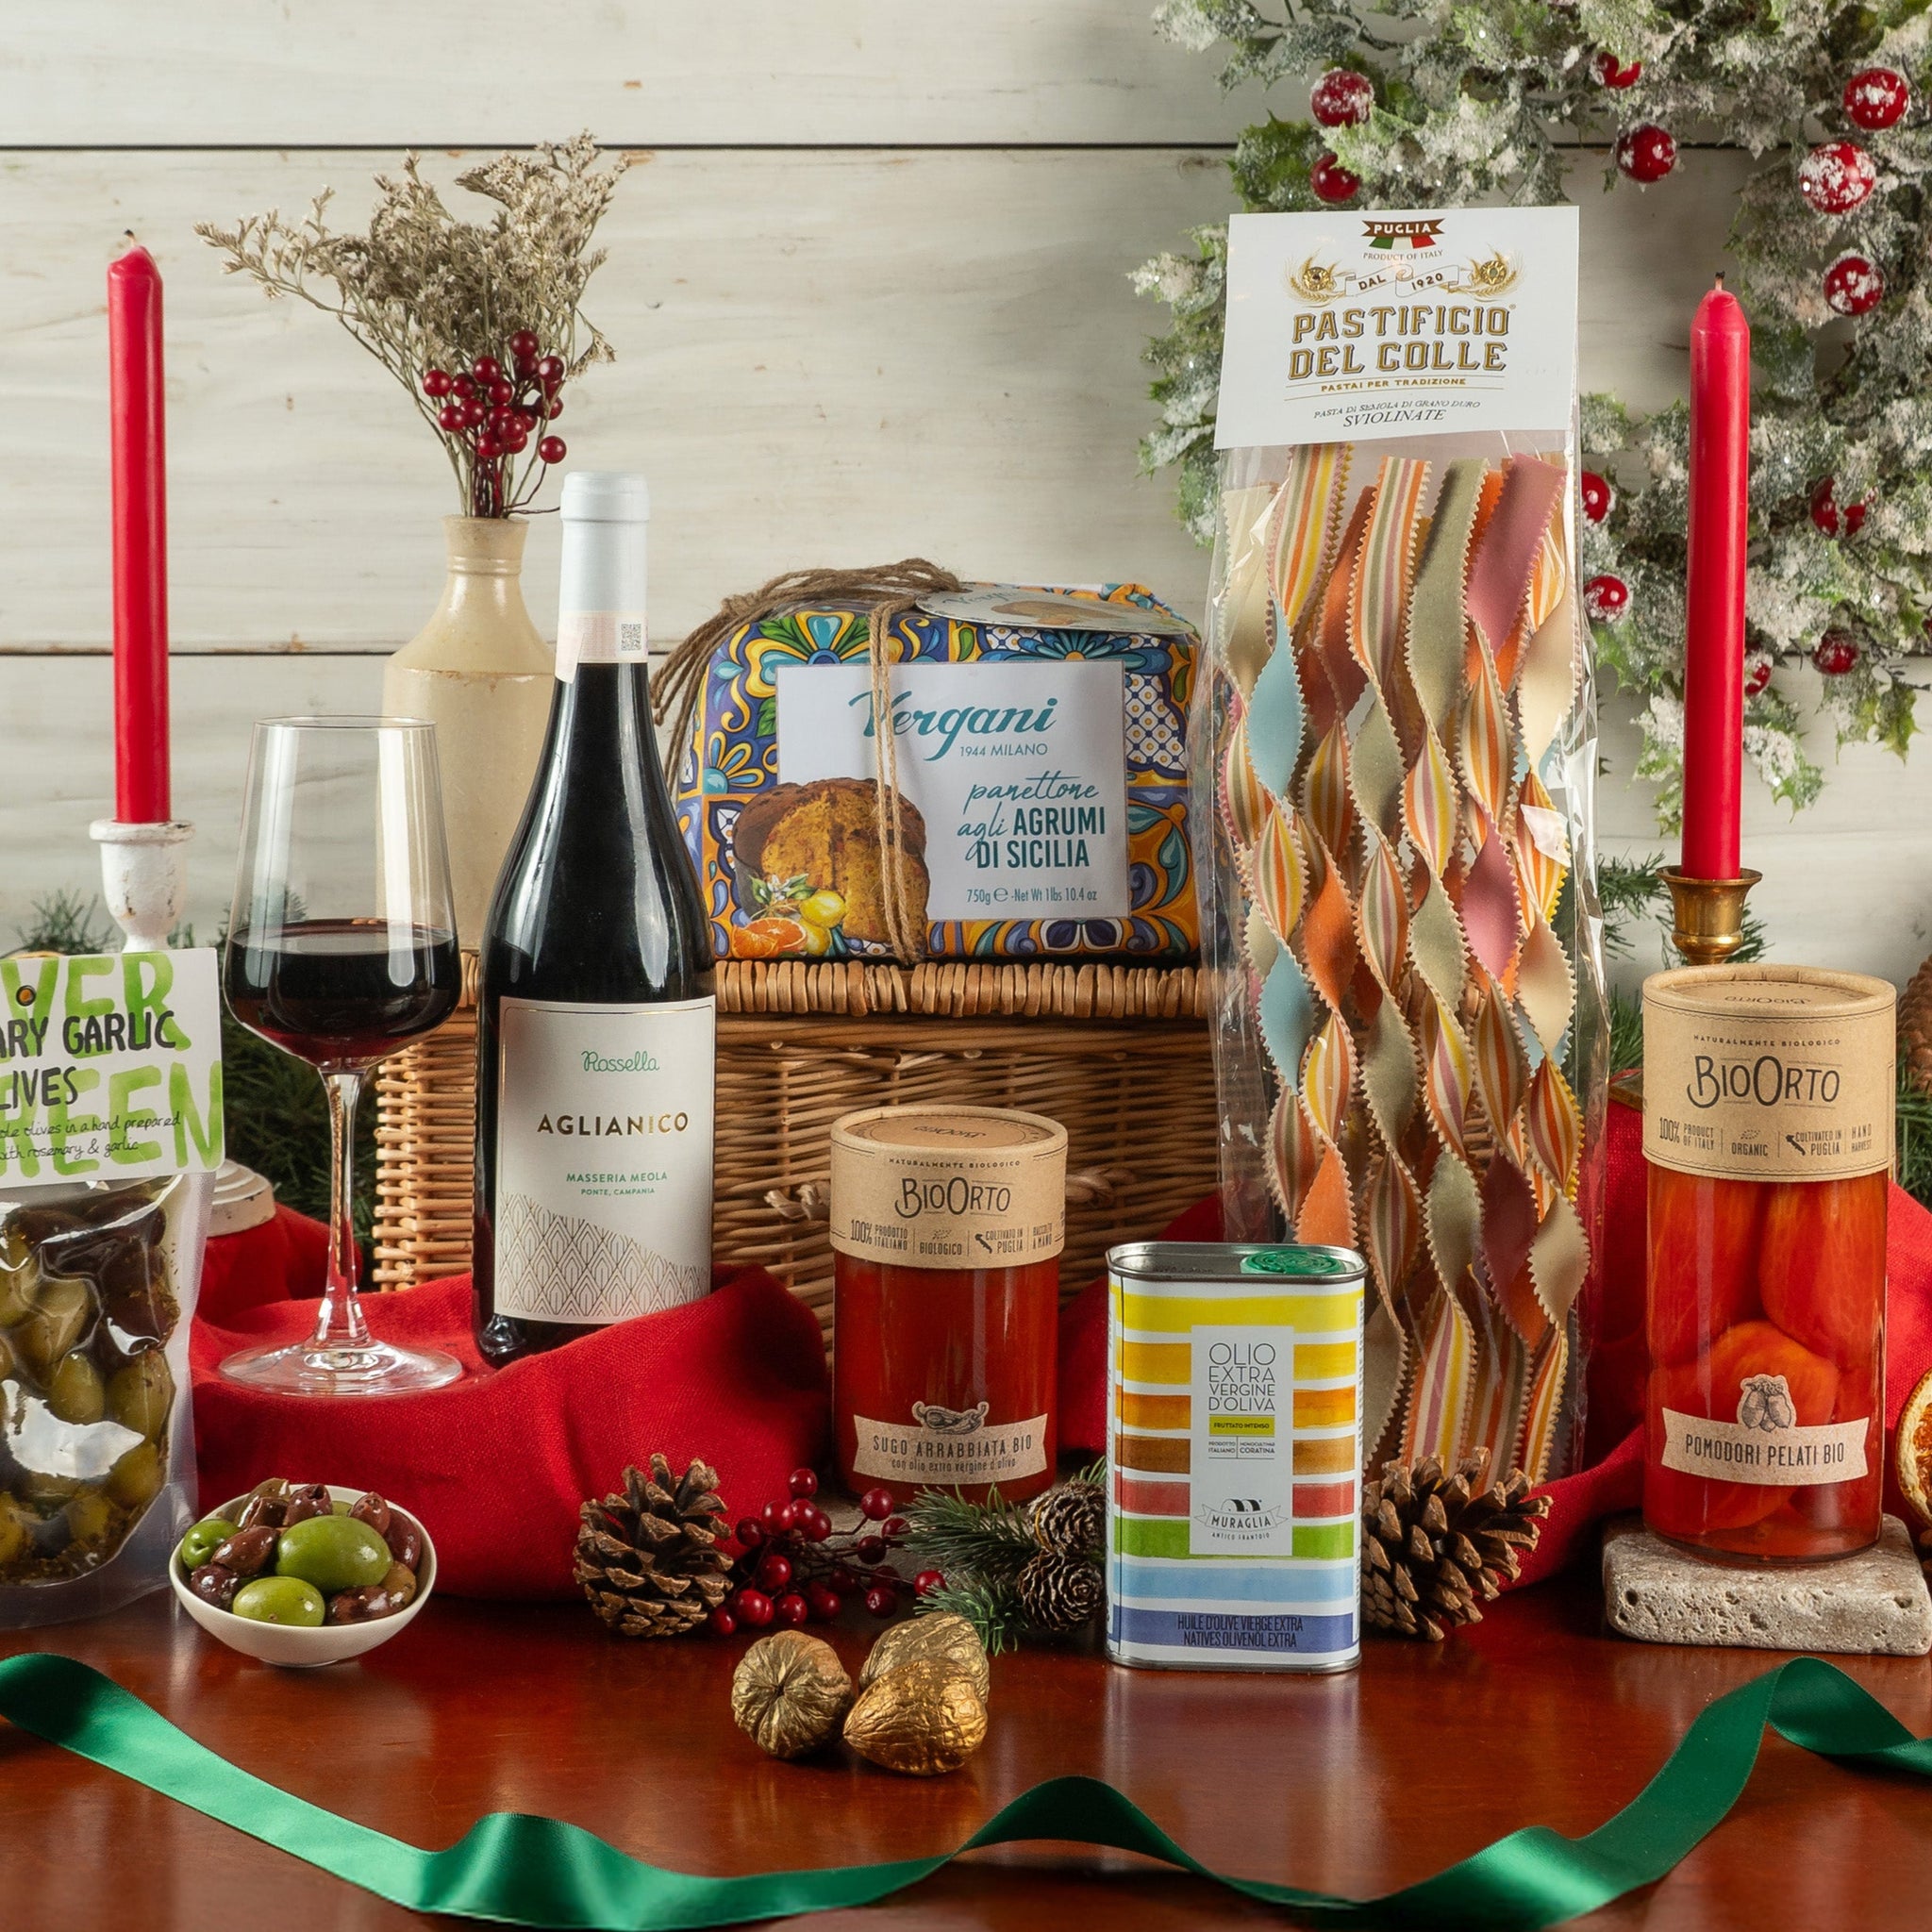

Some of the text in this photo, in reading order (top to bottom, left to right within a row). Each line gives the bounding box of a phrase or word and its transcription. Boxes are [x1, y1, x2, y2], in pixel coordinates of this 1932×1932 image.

[1373, 223, 1431, 234] PUGLIA
[1363, 252, 1404, 260] PRODUCT
[1420, 249, 1443, 258] ITALY
[1358, 273, 1443, 291] DAL 1920
[1291, 305, 1510, 343] PASTIFICIO
[1288, 341, 1508, 380] DEL COLLE
[1321, 383, 1363, 392] PASTAI
[1395, 378, 1466, 387] TRADIZIONE
[1314, 408, 1343, 419] PASTA
[1359, 402, 1399, 411] SEMOLA
[1401, 400, 1413, 408] DI
[1451, 400, 1481, 408] DURO
[1342, 408, 1447, 427] SVIOLINATE
[848, 690, 1058, 762] Vergani
[960, 742, 1048, 758] 1944 MILANO
[962, 770, 1100, 815] panettone
[957, 802, 1106, 861] agli AGRUMI
[976, 839, 1091, 870] DI SICILIA
[967, 889, 991, 906] 750g
[1031, 888, 1042, 902] Wt
[1065, 887, 1085, 901] 10.4
[1087, 890, 1098, 901] oz
[0, 953, 192, 1059] VER
[62, 1010, 176, 1055] GARLIC
[1693, 1035, 1840, 1047] NATURALMENTE BIOLOGICO
[581, 1051, 660, 1073] Rossella
[25, 1120, 60, 1137] olives
[66, 1122, 77, 1133] in
[81, 1124, 91, 1132] a
[92, 1115, 120, 1132] hand
[124, 1111, 181, 1133] prepared
[537, 1111, 689, 1137] AGLIANICO
[1659, 1117, 1714, 1143] 100% PRODUCT
[1851, 1124, 1872, 1139] HAND
[1683, 1136, 1714, 1150] OF ITALY
[1795, 1130, 1841, 1142] CULTIVATED IN
[27, 1143, 83, 1159] rosemary
[88, 1138, 99, 1155] &
[104, 1137, 140, 1158] garlic
[1732, 1142, 1769, 1157] ORGANIC
[1810, 1142, 1840, 1157] PUGLIA
[889, 1158, 963, 1168] NATURALMENTE
[566, 1172, 668, 1184] MASSERIA MEOLA
[581, 1188, 656, 1197] PONTE, CAMPANIA
[851, 1219, 908, 1245] 100% PRODOTTO
[986, 1228, 1015, 1241] COLTIVATO
[874, 1236, 908, 1251] ITALIANO
[919, 1241, 962, 1256] BIOLOGICO
[997, 1240, 1024, 1254] PUGLIA
[1208, 1342, 1276, 1366] OLIO
[1208, 1366, 1275, 1383] EXTRA
[1208, 1383, 1275, 1397] VERGINE
[1208, 1397, 1275, 1411] D'OLIVA
[874, 1434, 1032, 1458] SUGO ARRABBIATA BIO
[1686, 1433, 1844, 1466] POMODORI PELATI BIO
[956, 1459, 987, 1474] vergine
[1211, 1514, 1272, 1528] MURAGLIA
[1178, 1614, 1304, 1632] HUILE D'OLIVE VIERGE EXTRA
[1184, 1631, 1221, 1646] NATIVES
[1268, 1633, 1297, 1648] EXTRA
